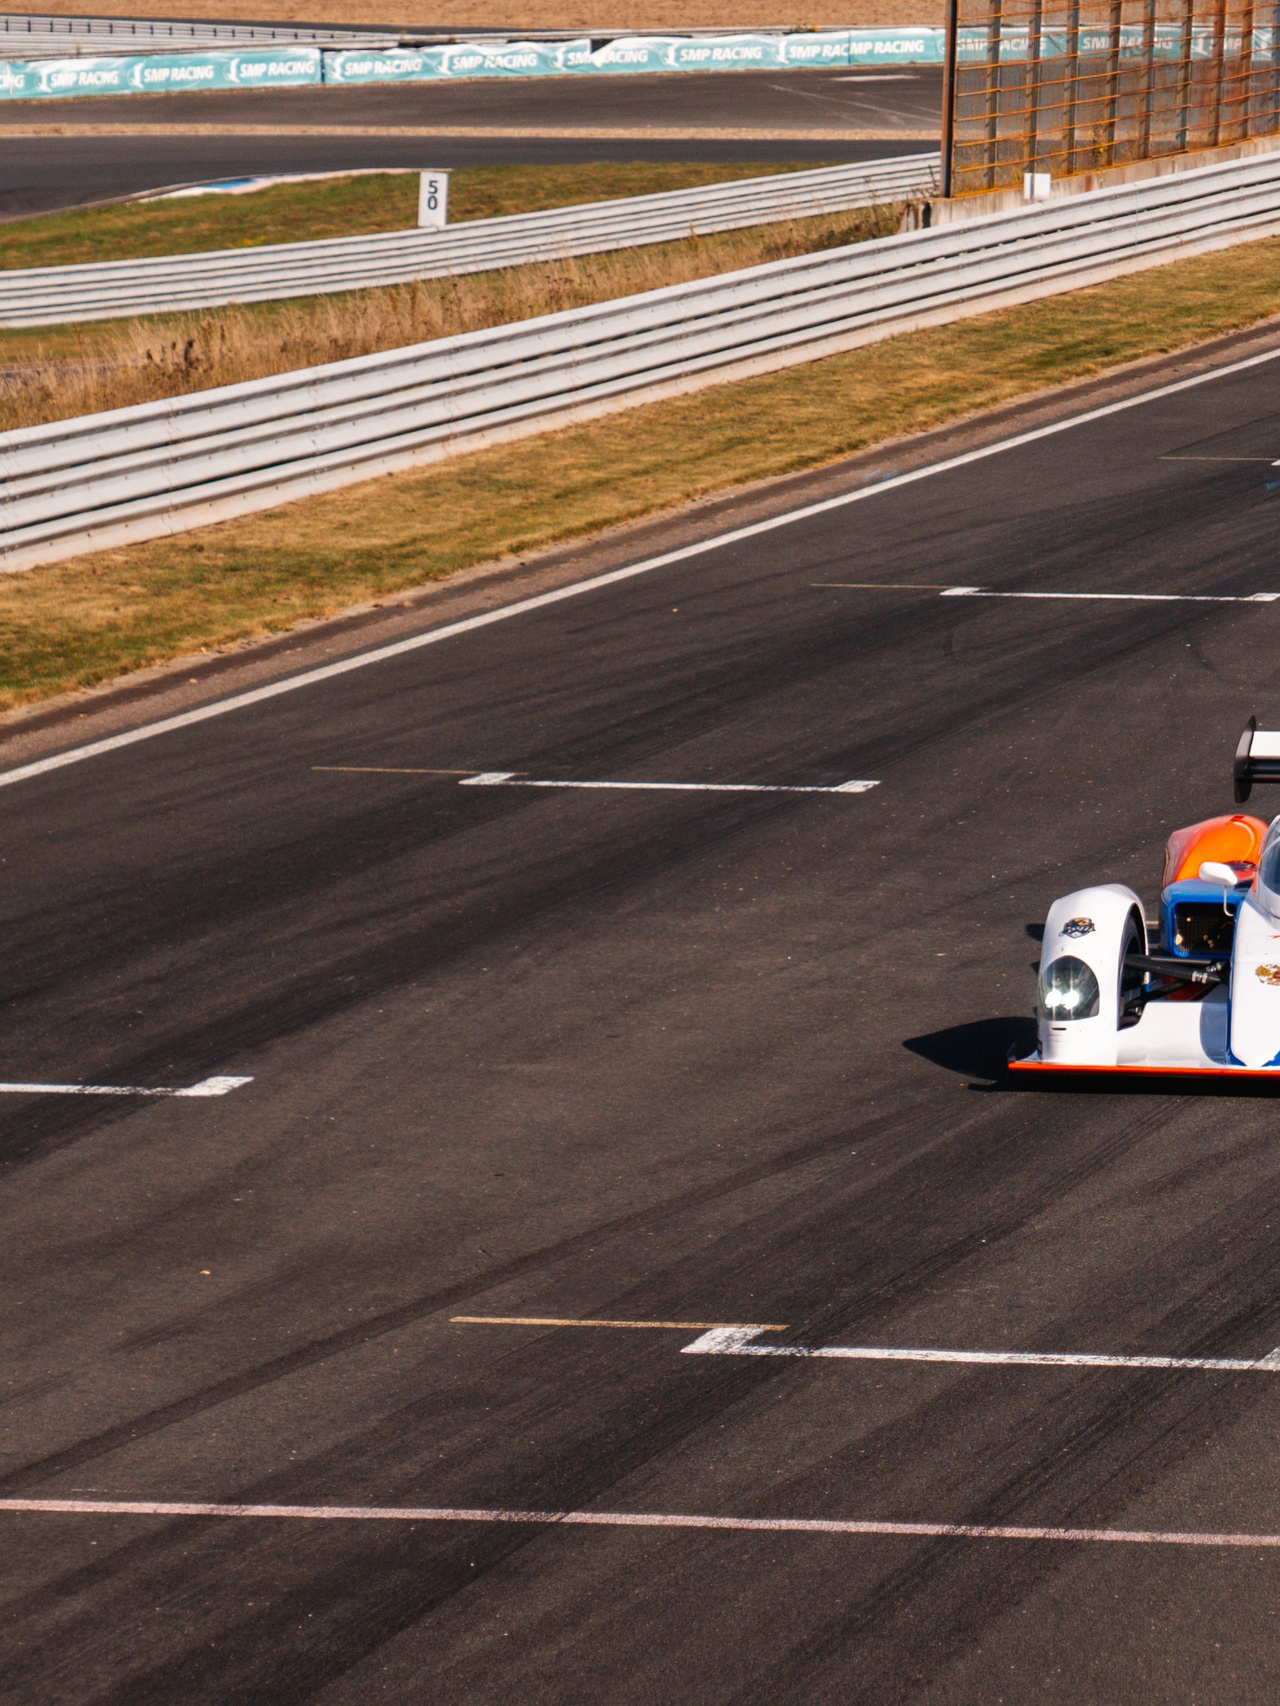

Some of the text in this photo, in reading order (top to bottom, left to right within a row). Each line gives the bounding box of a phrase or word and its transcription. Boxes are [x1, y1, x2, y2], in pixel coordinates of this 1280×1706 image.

[680, 46, 763, 62] SMP RACING
[789, 45, 820, 59] SMP
[874, 39, 925, 54] RACING
[452, 53, 537, 70] SMP RACING
[601, 50, 648, 64] ACING
[144, 65, 214, 83] SMP RACING
[240, 60, 316, 78] SMP RACING
[344, 57, 423, 76] SMP RACING
[50, 70, 119, 88] SMP RACING
[427, 180, 438, 211] 50
